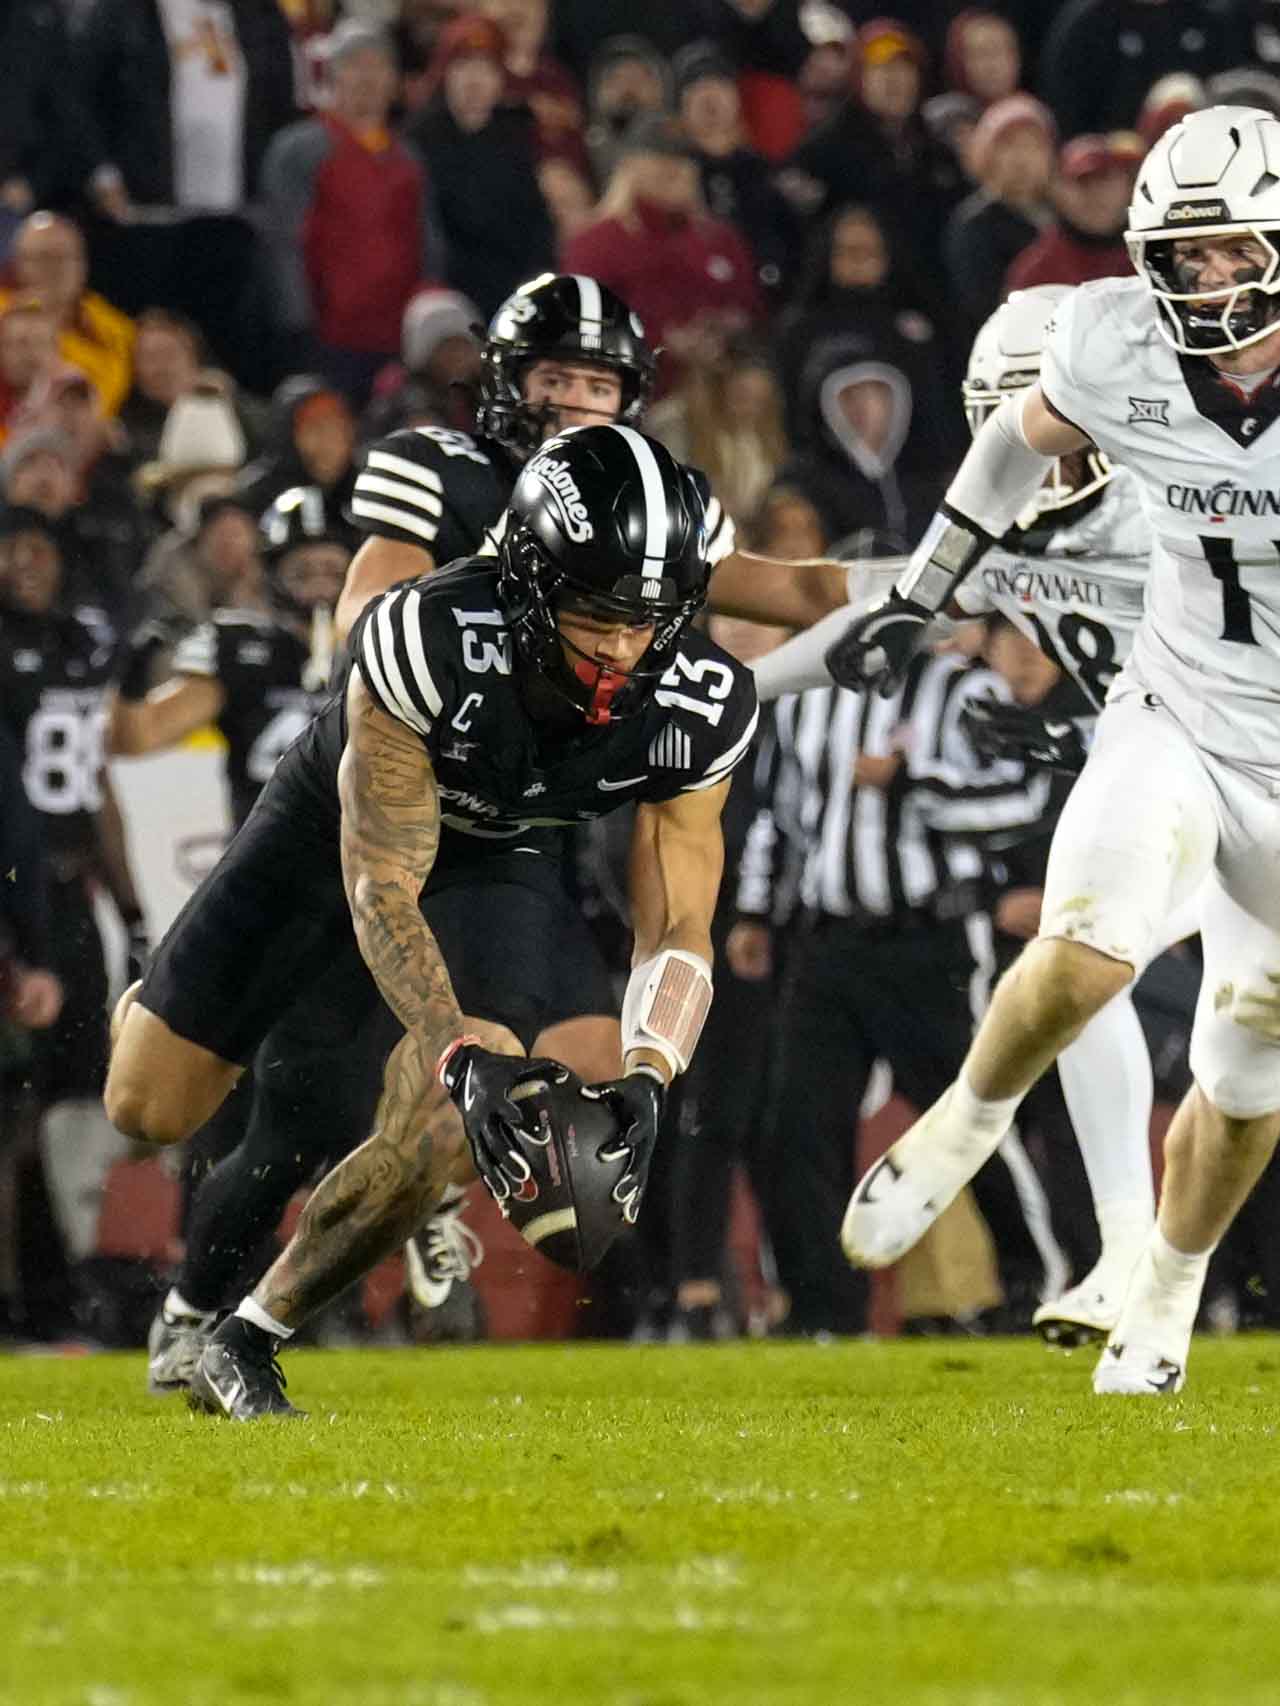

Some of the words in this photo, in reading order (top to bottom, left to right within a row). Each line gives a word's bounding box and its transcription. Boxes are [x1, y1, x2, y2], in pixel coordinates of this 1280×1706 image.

[983, 567, 1105, 606] CINCINNATI
[450, 606, 513, 675] 13
[654, 651, 735, 727] 13
